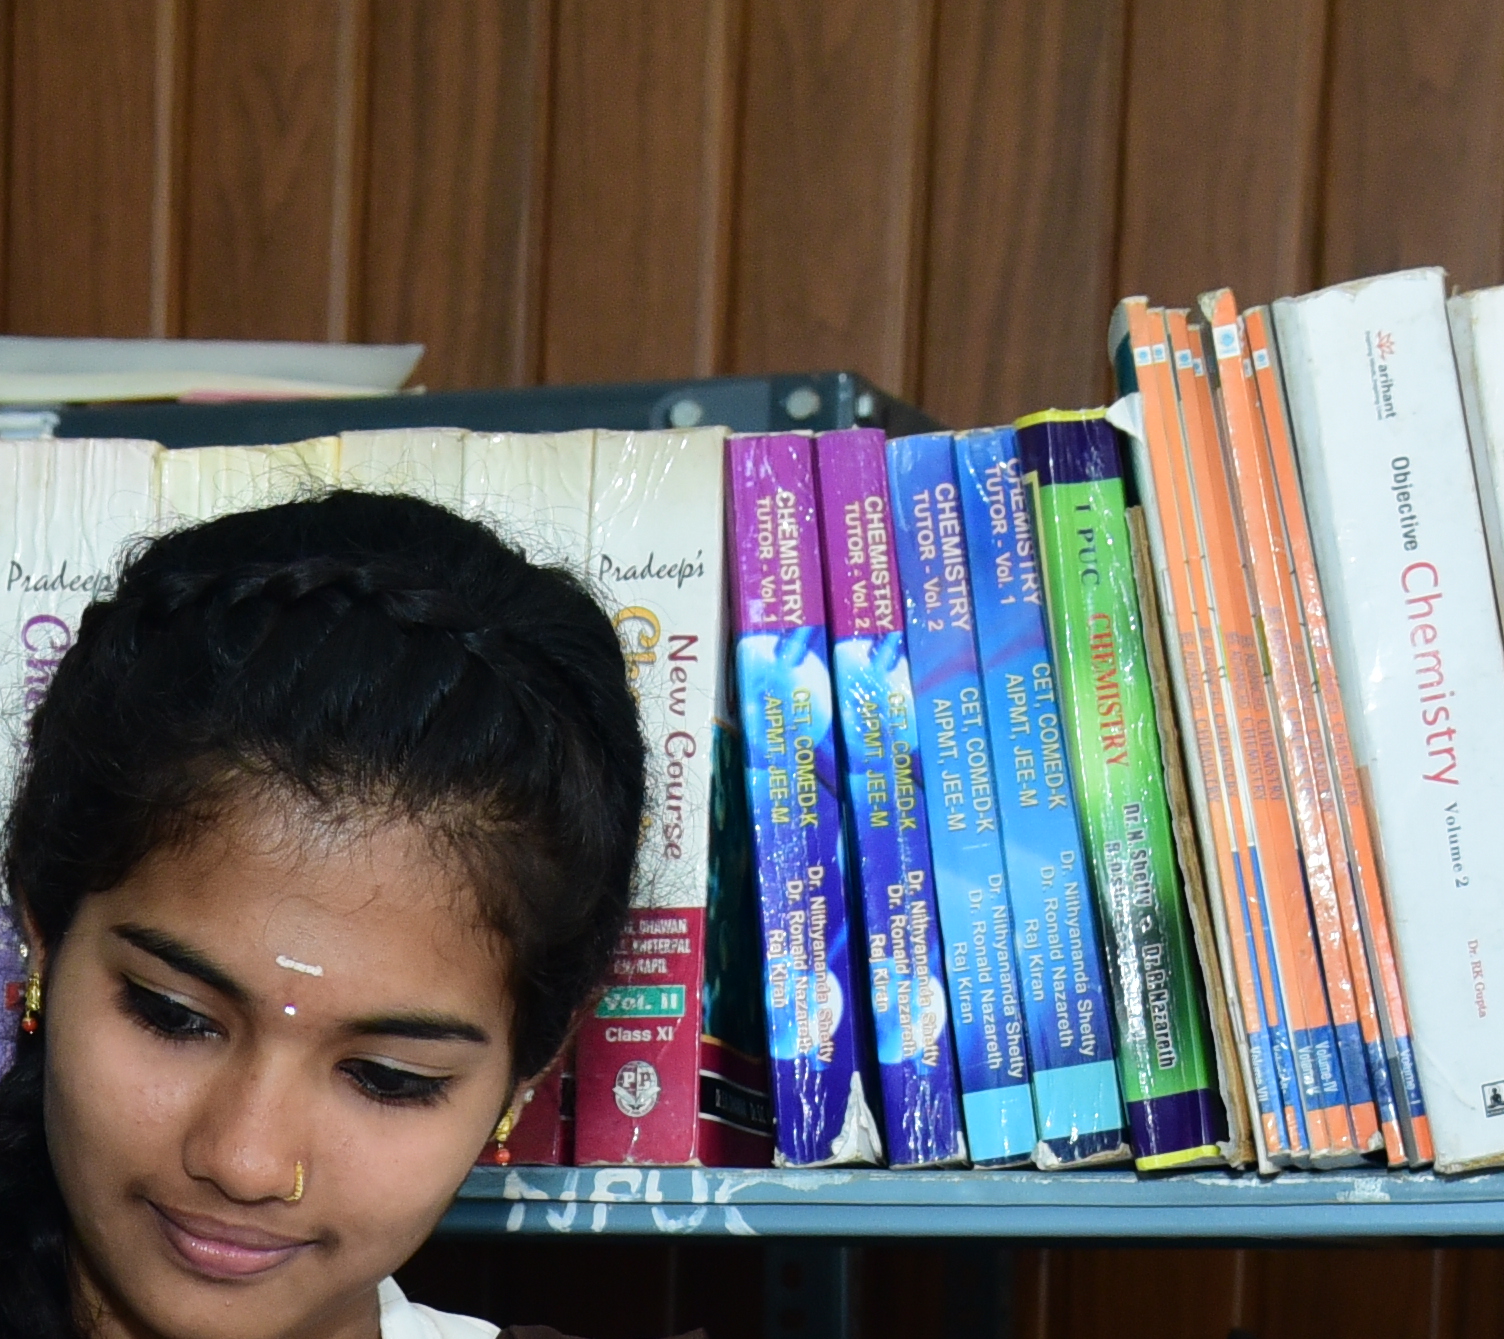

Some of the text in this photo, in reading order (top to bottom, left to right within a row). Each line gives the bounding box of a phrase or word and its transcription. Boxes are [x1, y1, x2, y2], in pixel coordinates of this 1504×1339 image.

[1378, 364, 1397, 419] arihant
[598, 551, 704, 589] Pradeep's
[913, 490, 943, 631] TUTOR Vol. 2
[935, 483, 971, 631] CHEMISTRY
[1391, 456, 1459, 785] Objective Chemistry
[664, 635, 698, 861] New Course
[1087, 613, 1127, 768] CHEMISTRY
[933, 698, 966, 831] AIPMT, JEE-M
[960, 688, 996, 833] CET, COMED-K
[1444, 802, 1469, 888] Volume 2
[958, 976, 973, 1024] Kiran
[972, 920, 991, 982] Ronald
[1002, 1019, 1023, 1078] Shetty
